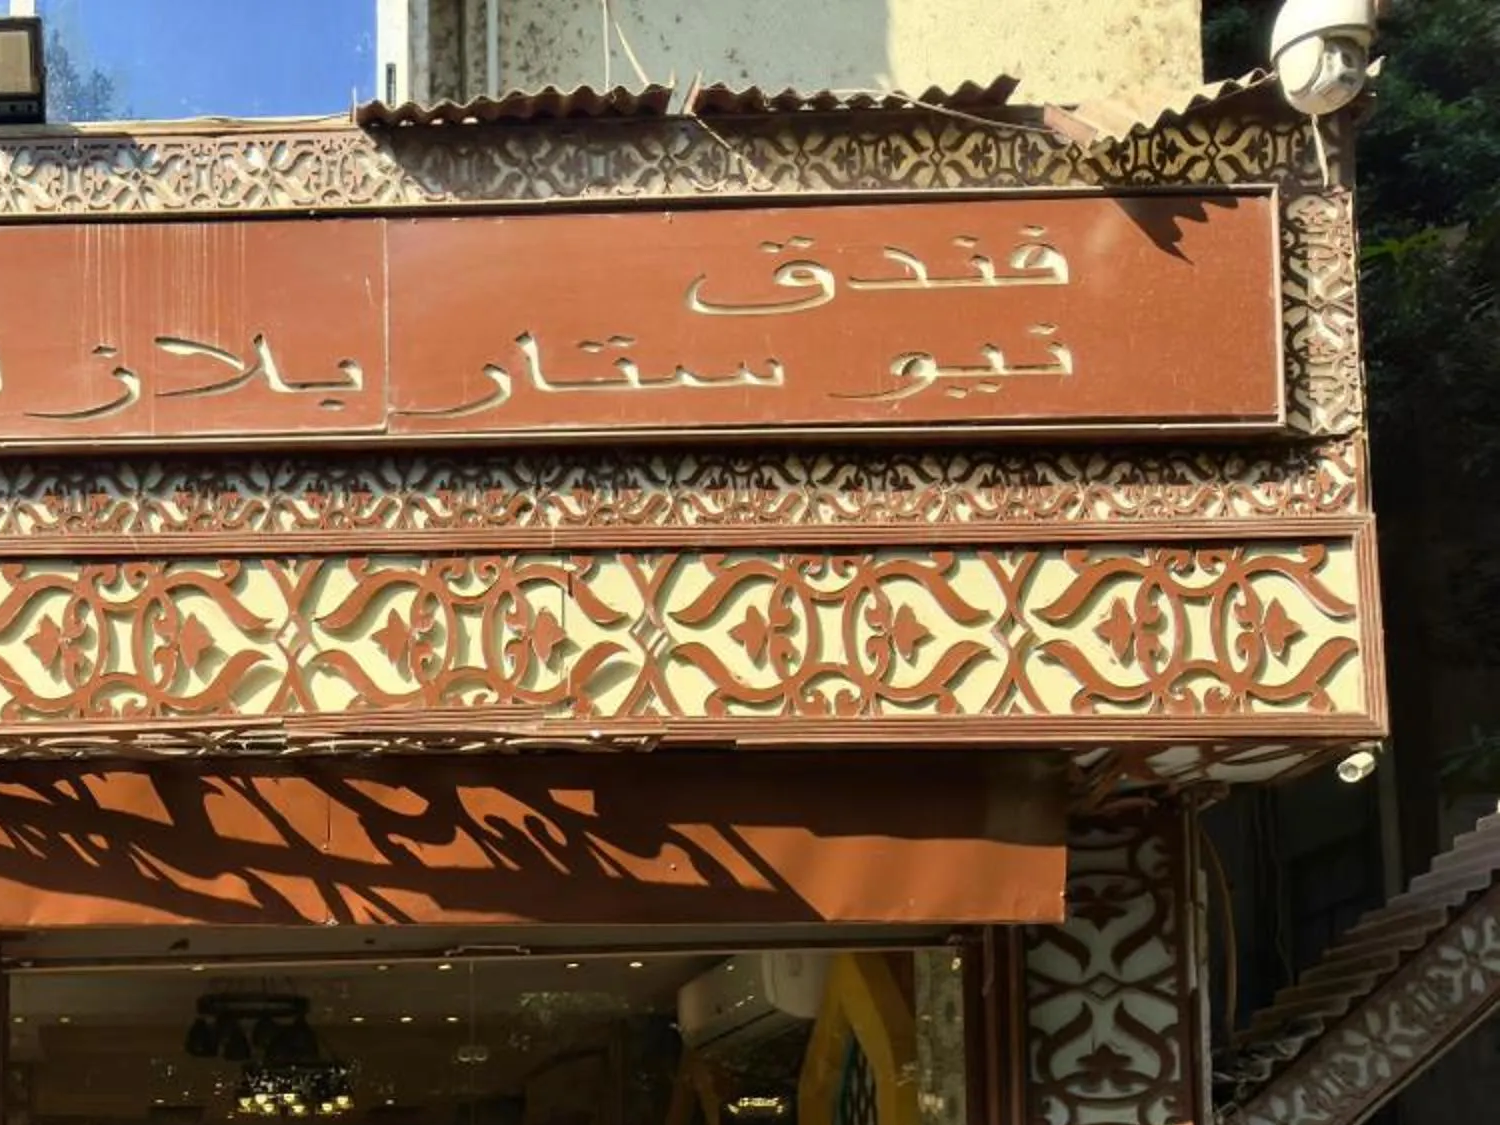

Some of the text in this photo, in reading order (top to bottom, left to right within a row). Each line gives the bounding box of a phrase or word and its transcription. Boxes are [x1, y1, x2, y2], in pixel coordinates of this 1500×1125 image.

[686, 224, 1069, 316] فندق
[388, 330, 785, 419] ستار
[827, 321, 1072, 402] نيو
